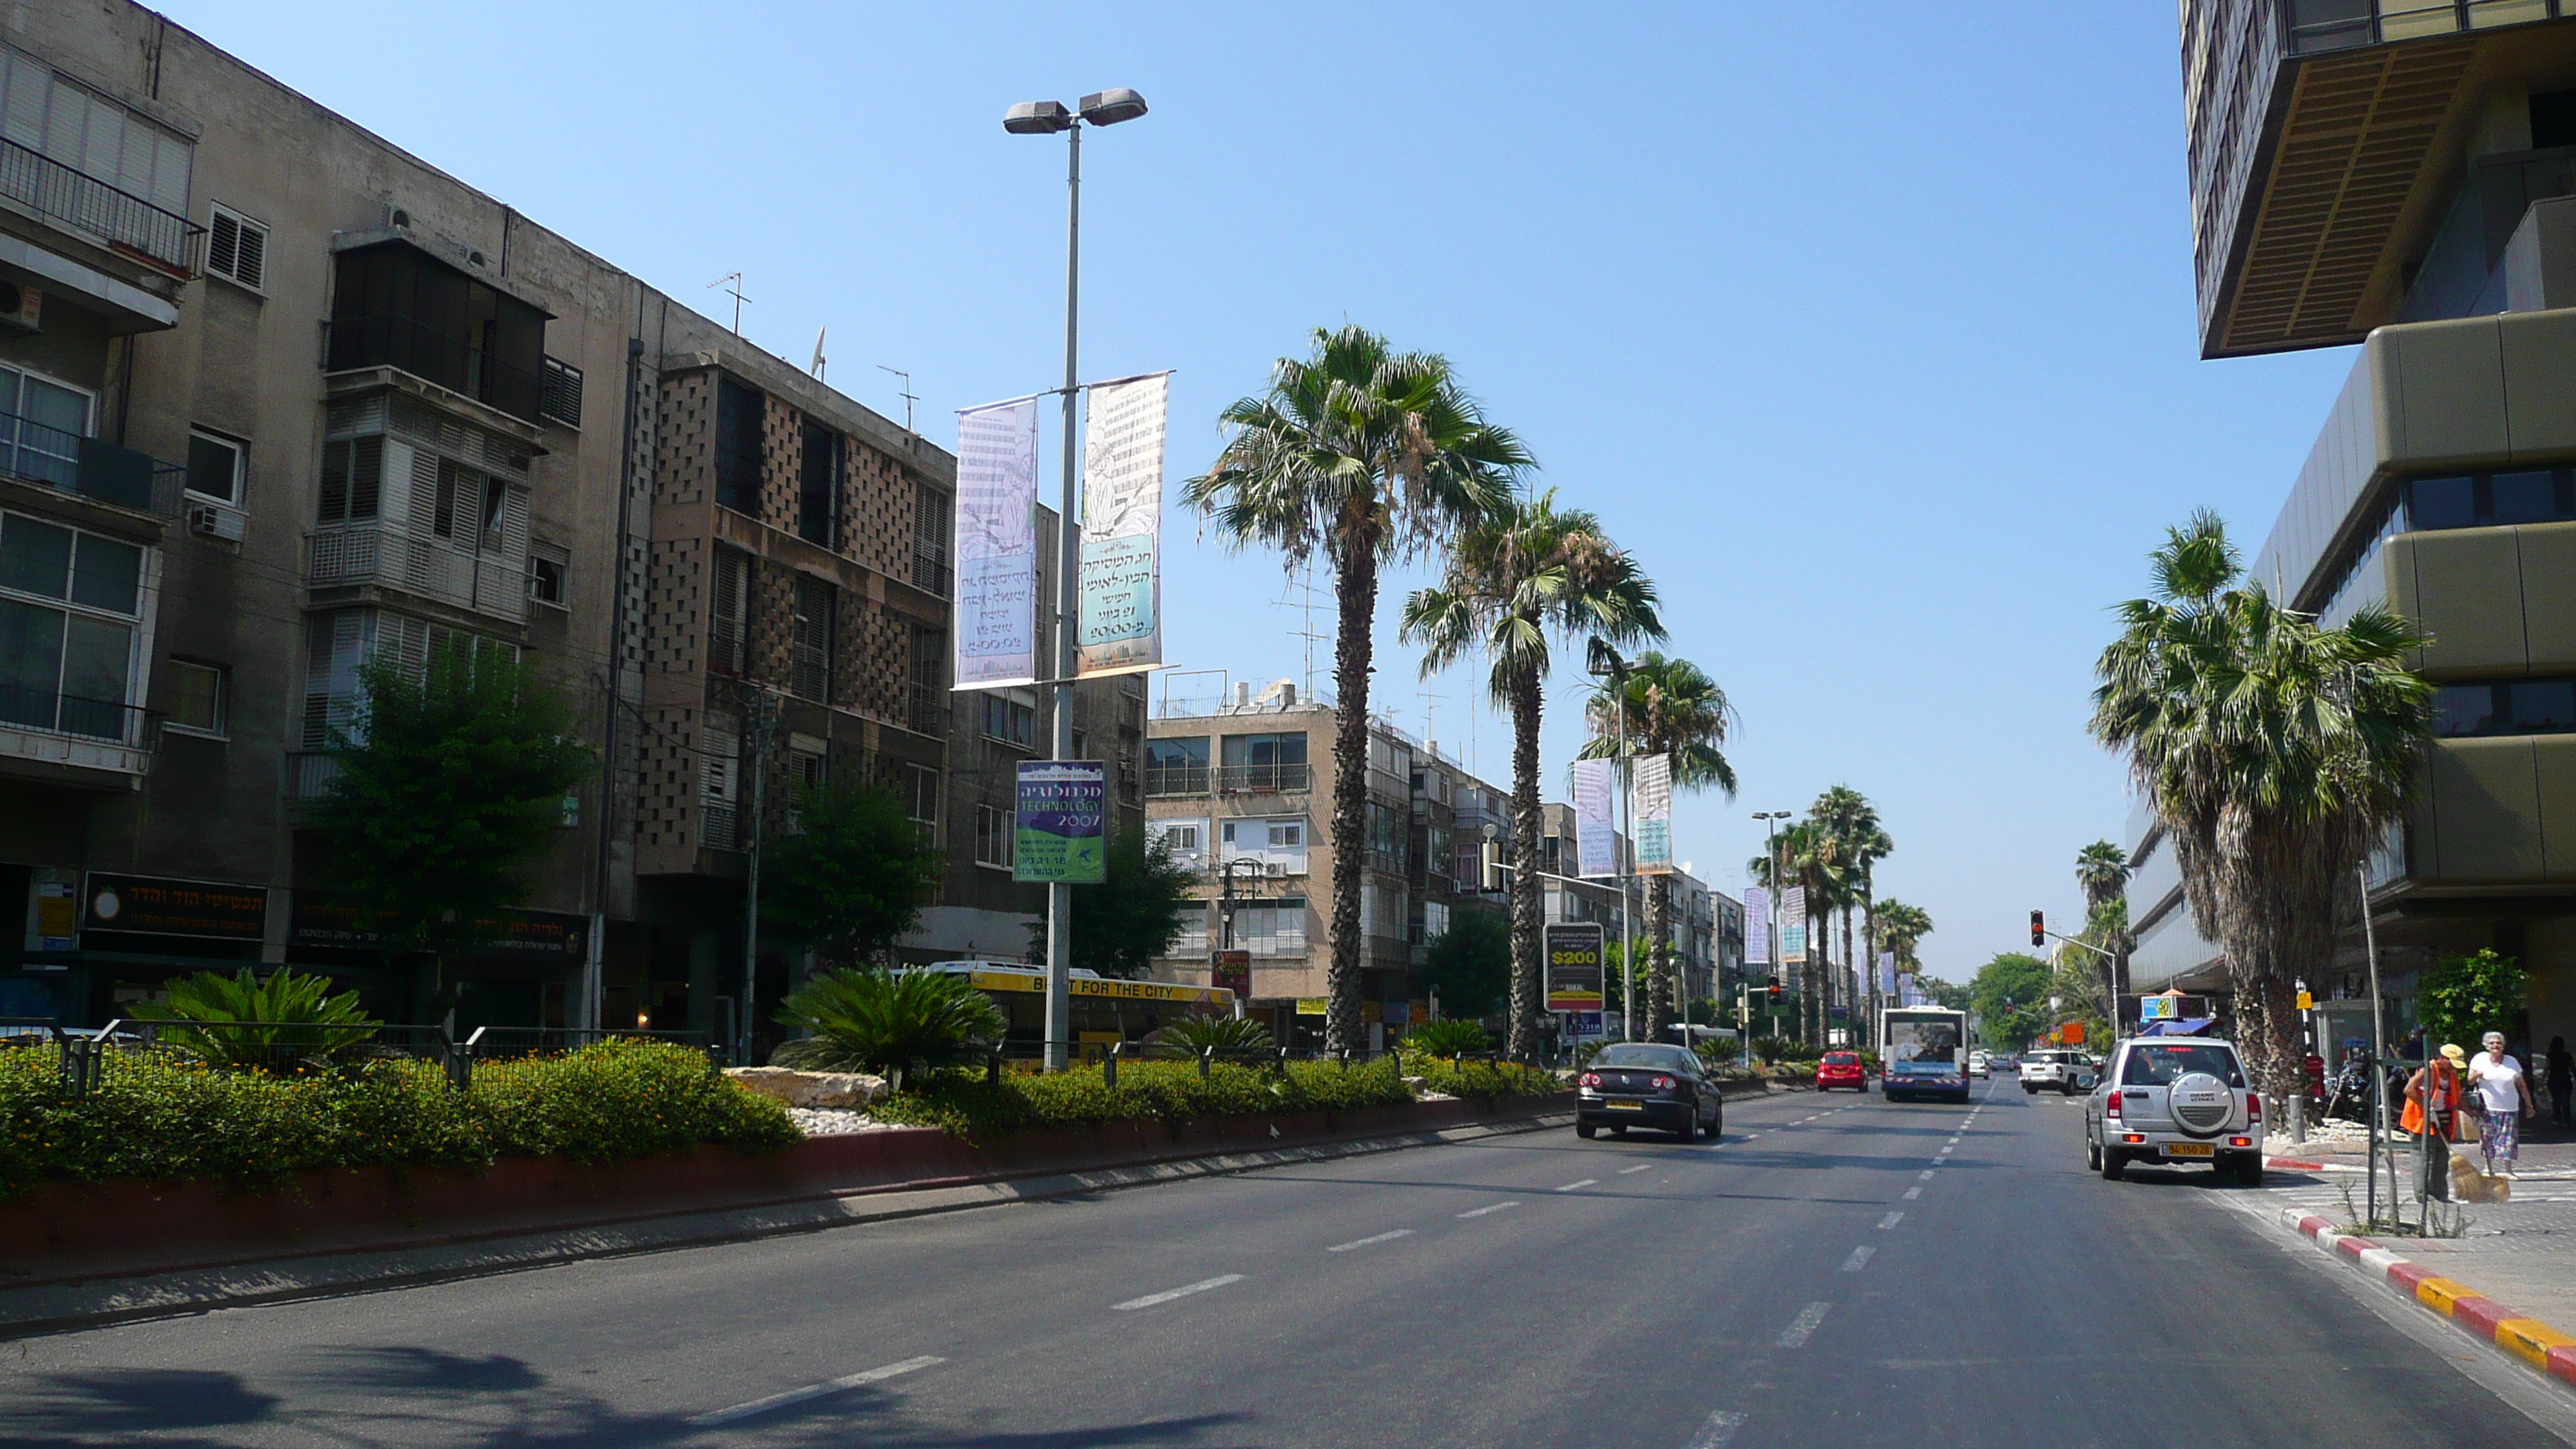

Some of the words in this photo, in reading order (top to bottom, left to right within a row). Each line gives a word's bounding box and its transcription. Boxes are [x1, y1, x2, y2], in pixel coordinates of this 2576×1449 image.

[1084, 555, 1133, 575] המוסיקה
[1135, 552, 1152, 565] חג
[1087, 570, 1150, 591] הבין-לאומי
[1102, 592, 1131, 605] חמישי
[1098, 608, 1120, 622] ביוני
[1122, 605, 1136, 618] 21
[1022, 799, 1099, 812] TECHNOLOGY
[1058, 815, 1100, 827] 2007
[130, 886, 168, 904] והדר
[172, 889, 200, 906] הוד
[205, 892, 263, 913] תכשיטי
[1552, 951, 1597, 964] $200
[1081, 981, 1109, 995] FOR
[1115, 984, 1139, 997] THE
[1145, 985, 1173, 999] CITY
